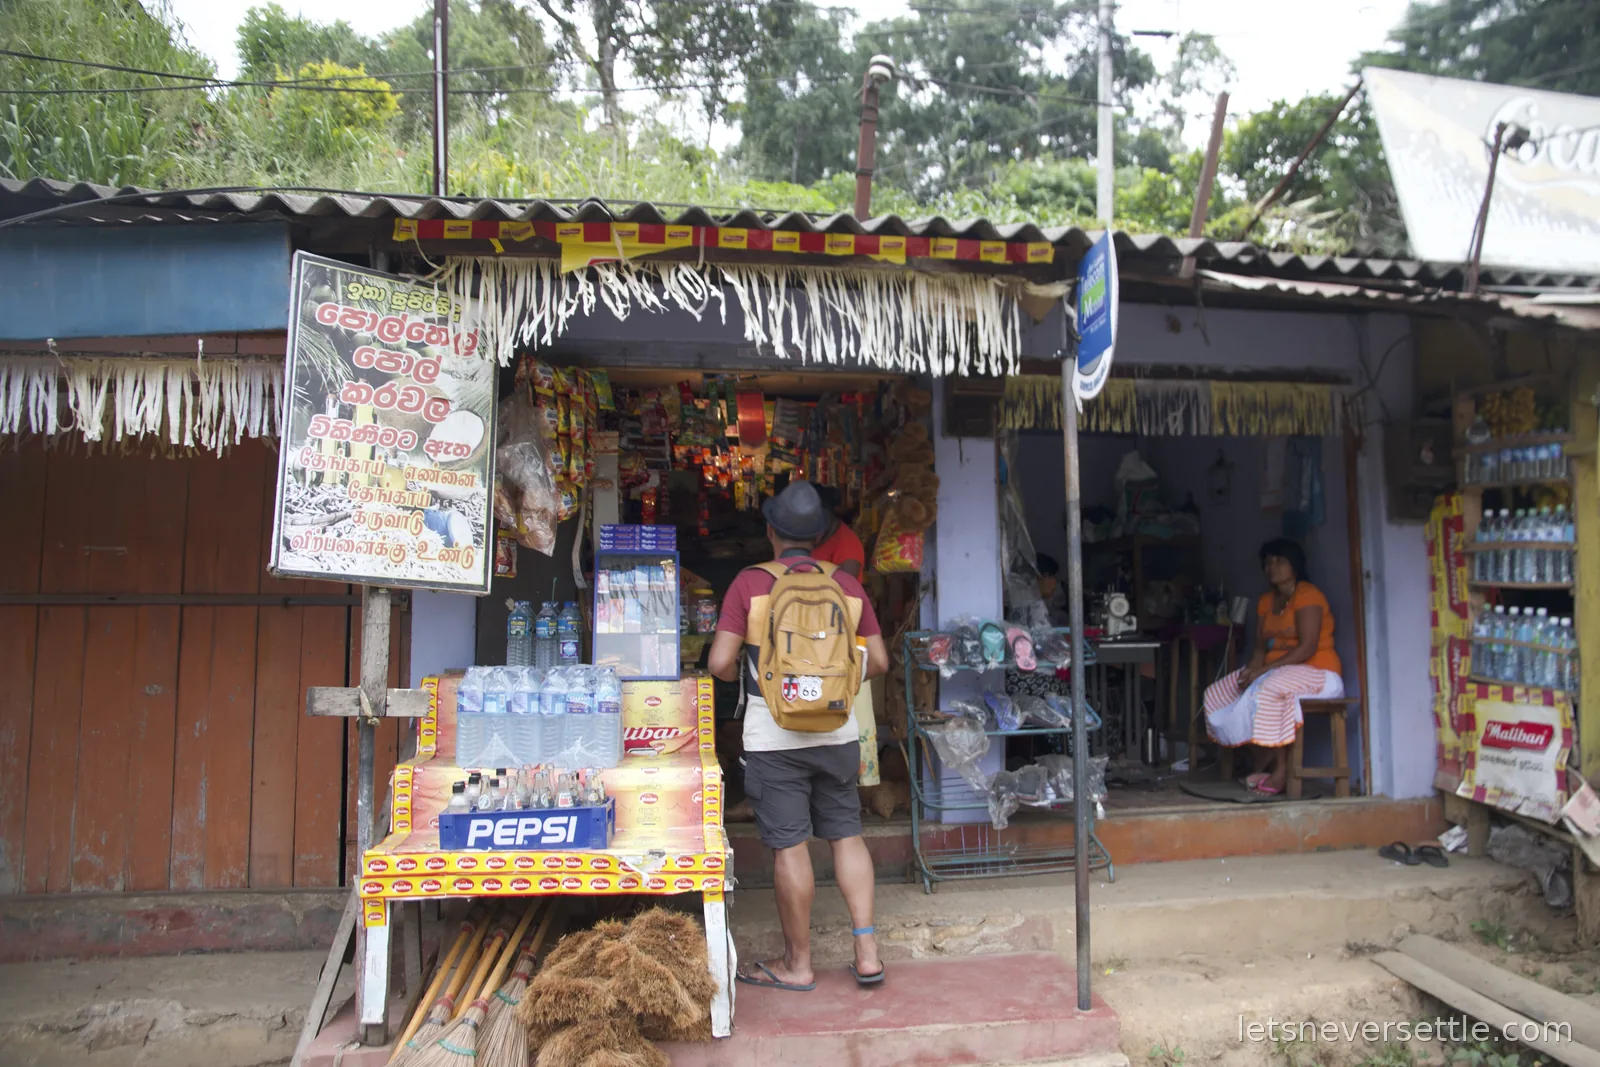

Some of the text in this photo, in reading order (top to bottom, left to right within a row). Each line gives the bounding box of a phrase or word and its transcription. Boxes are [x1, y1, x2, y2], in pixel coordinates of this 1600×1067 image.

[353, 347, 441, 384] පොල්
[342, 381, 450, 422] කරවල
[300, 447, 385, 476] தேங்காய்
[425, 438, 471, 457] ඇත
[348, 480, 430, 507] தேங்காய்
[352, 510, 424, 535] கருவாடு
[1487, 723, 1547, 746] Maliban
[467, 816, 578, 847] PEPSI
